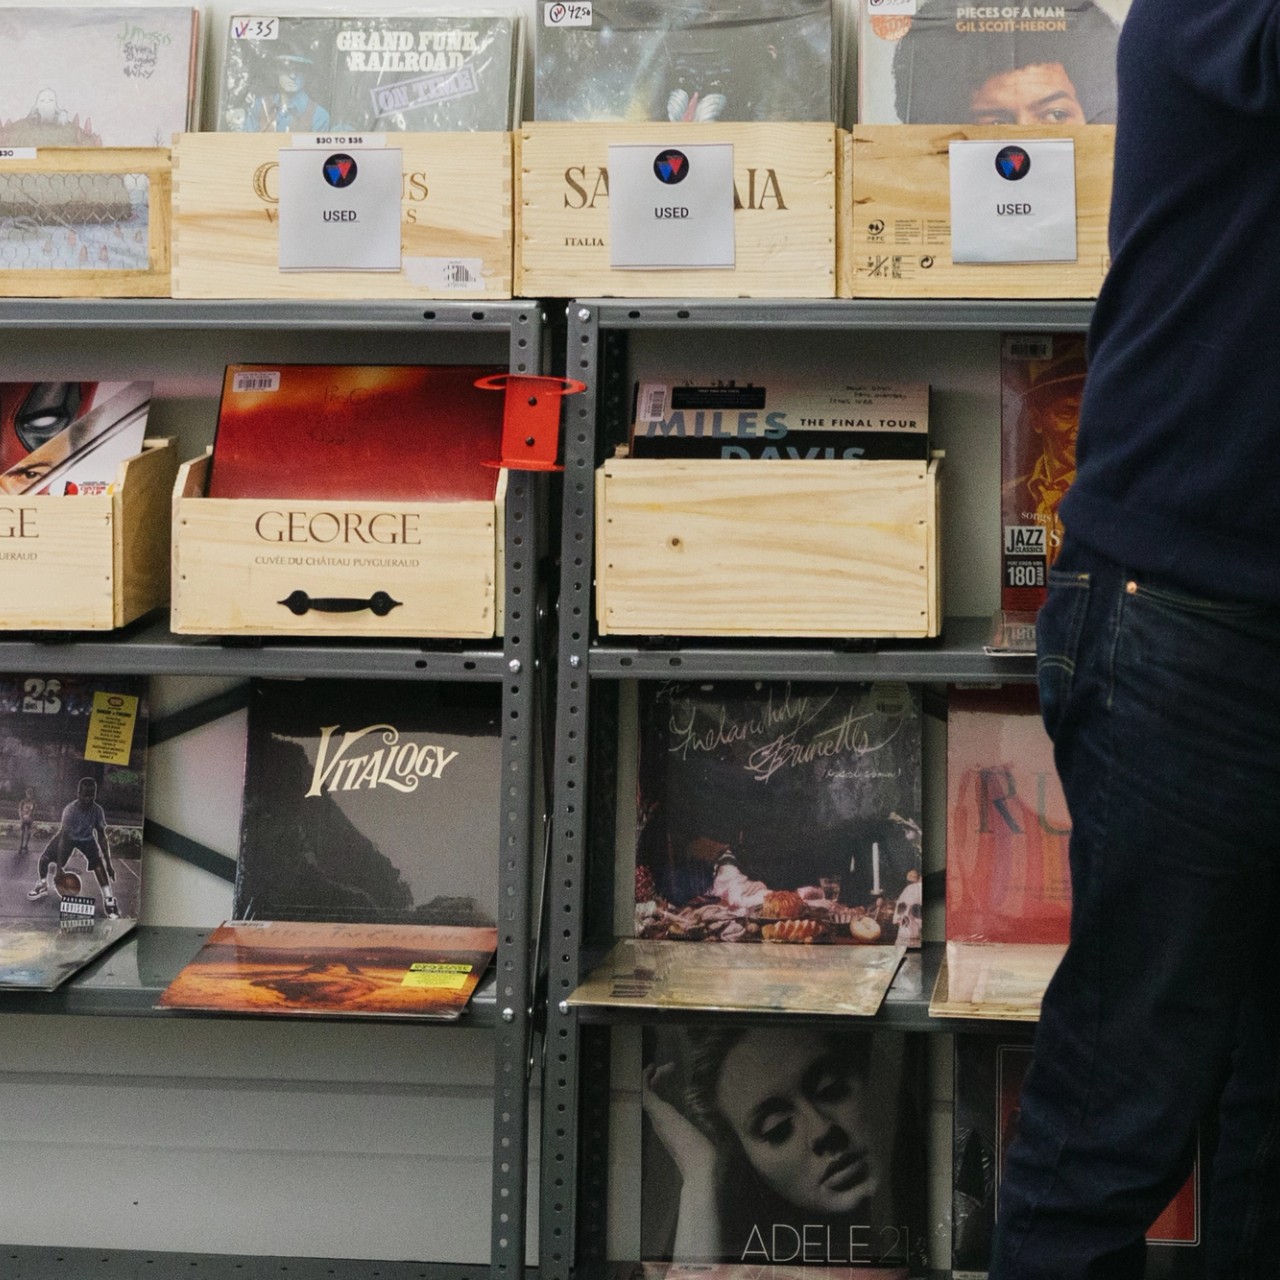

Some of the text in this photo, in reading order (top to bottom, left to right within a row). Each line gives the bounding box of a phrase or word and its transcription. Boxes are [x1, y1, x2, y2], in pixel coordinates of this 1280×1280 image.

[956, 6, 1066, 19] PIECES OF A MAN
[955, 19, 1066, 32] GIL SCOTT-HERON
[336, 30, 480, 52] GRAND FUNK
[348, 51, 465, 72] RAILROAD
[378, 89, 410, 111] ON
[316, 136, 363, 144] $30 TO $35
[322, 210, 358, 222] USED
[654, 207, 690, 219] USED
[996, 203, 1032, 215] USED
[564, 237, 605, 247] ITALIA
[646, 411, 917, 440] MILES THE FINAL TOUR
[255, 510, 422, 545] GEORGE
[1006, 528, 1044, 552] JAZZ
[255, 554, 420, 568] CUVÉE DU CHÂTEAU PUYGUERAUD
[1006, 567, 1036, 587] 180
[304, 723, 459, 799] VITALOGY
[60, 902, 95, 915] ADVISORY
[741, 1223, 909, 1264] ADELE 21
